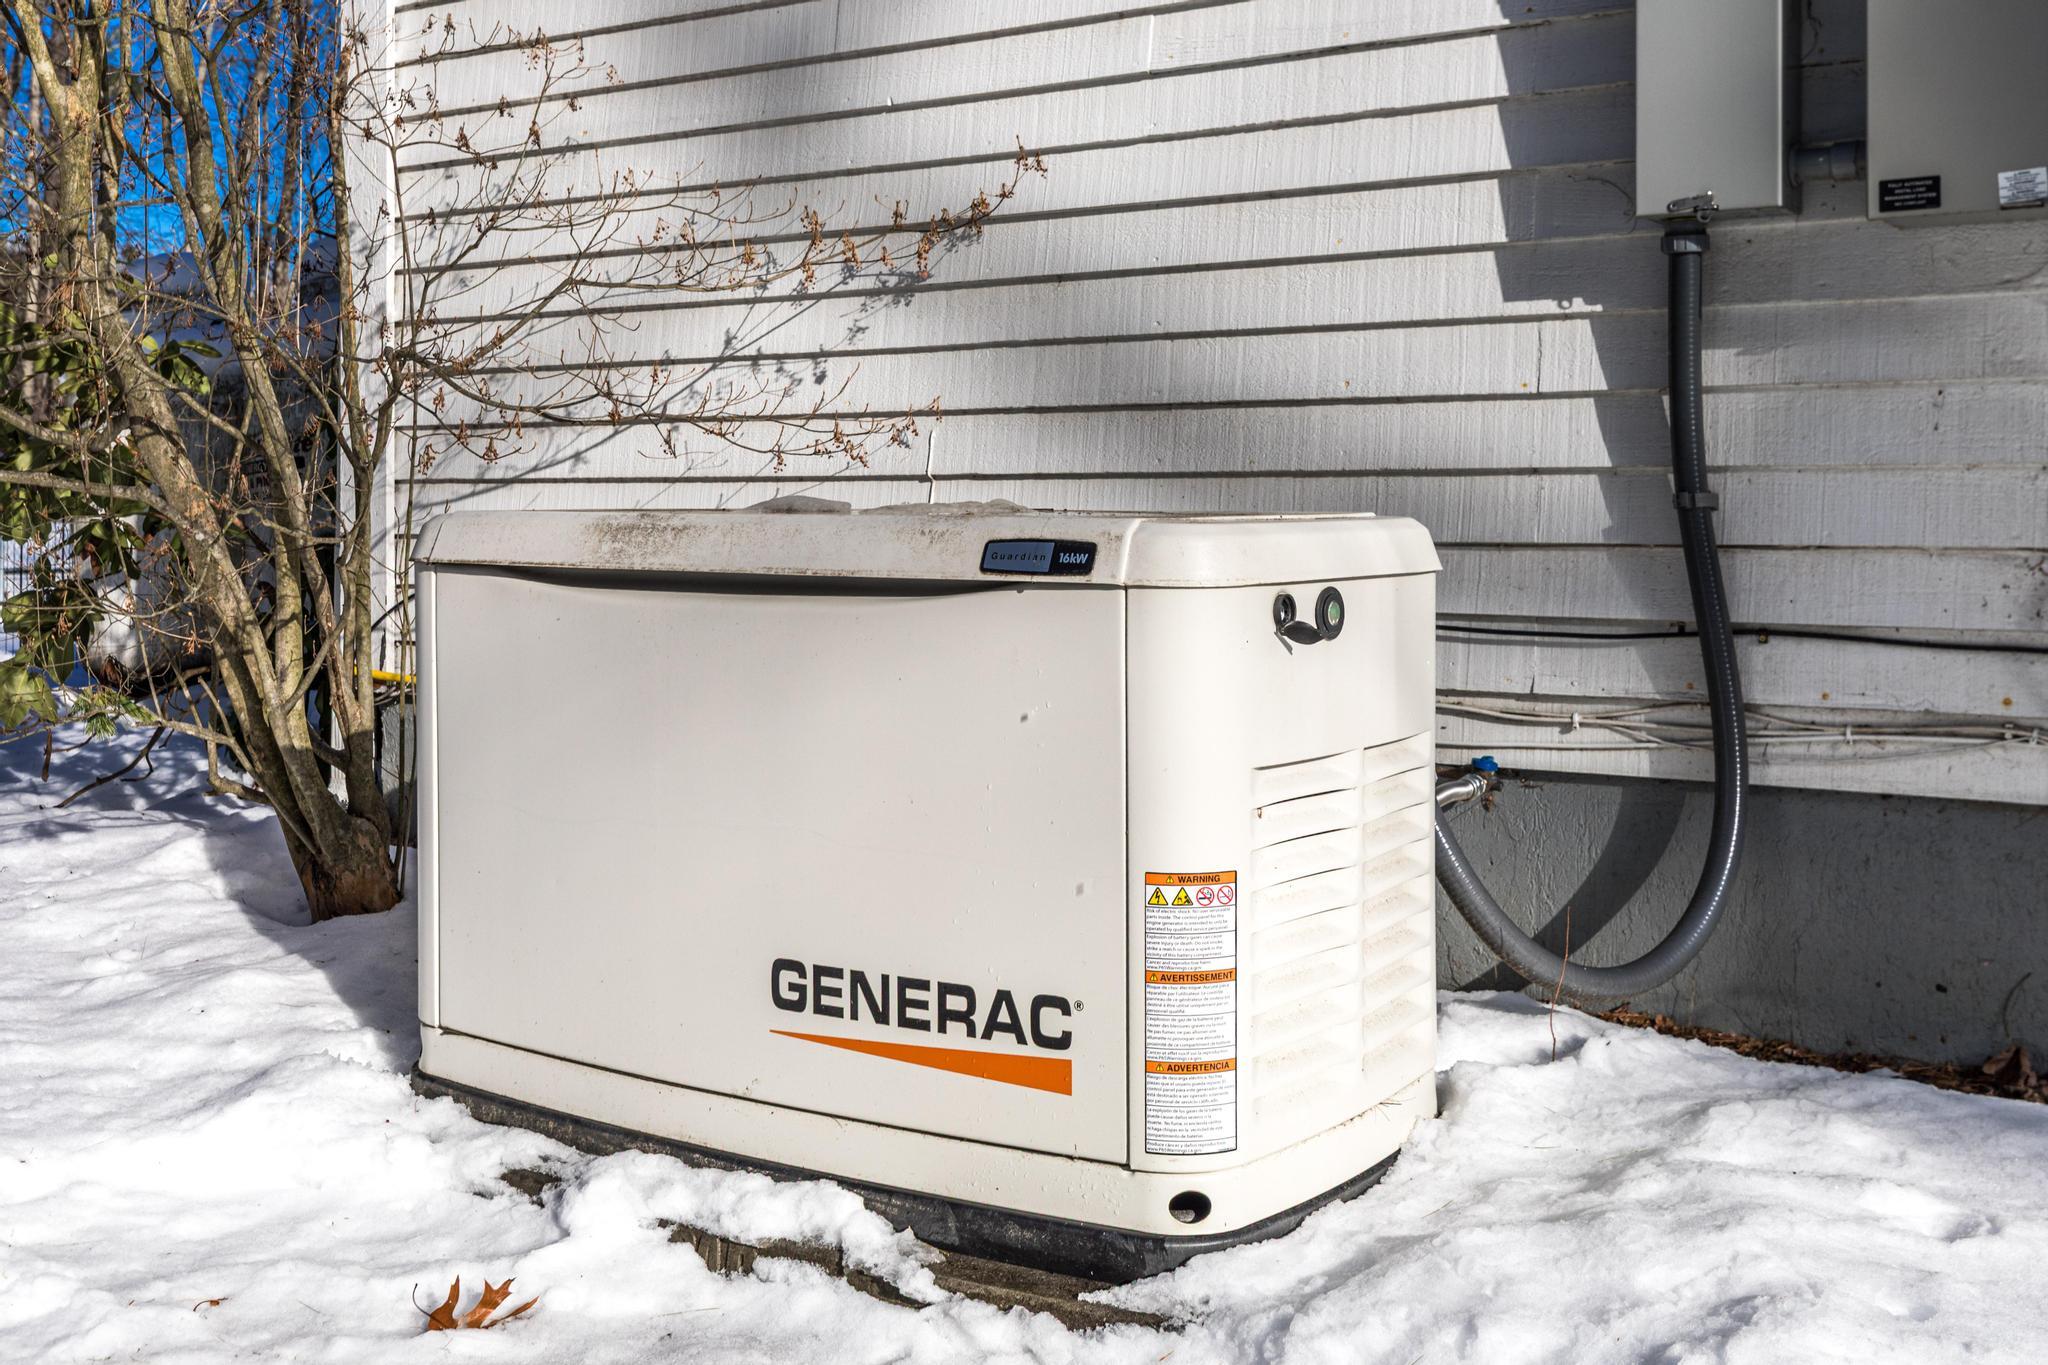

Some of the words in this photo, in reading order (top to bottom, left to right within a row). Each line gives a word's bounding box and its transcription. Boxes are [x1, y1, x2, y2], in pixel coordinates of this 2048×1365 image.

[991, 551, 1046, 561] Guardian
[1059, 553, 1089, 565] 16kW
[1177, 875, 1220, 883] WARNING
[1160, 971, 1233, 982] AVERTISSEMENT
[1167, 1062, 1230, 1072] ADVERTENCIA
